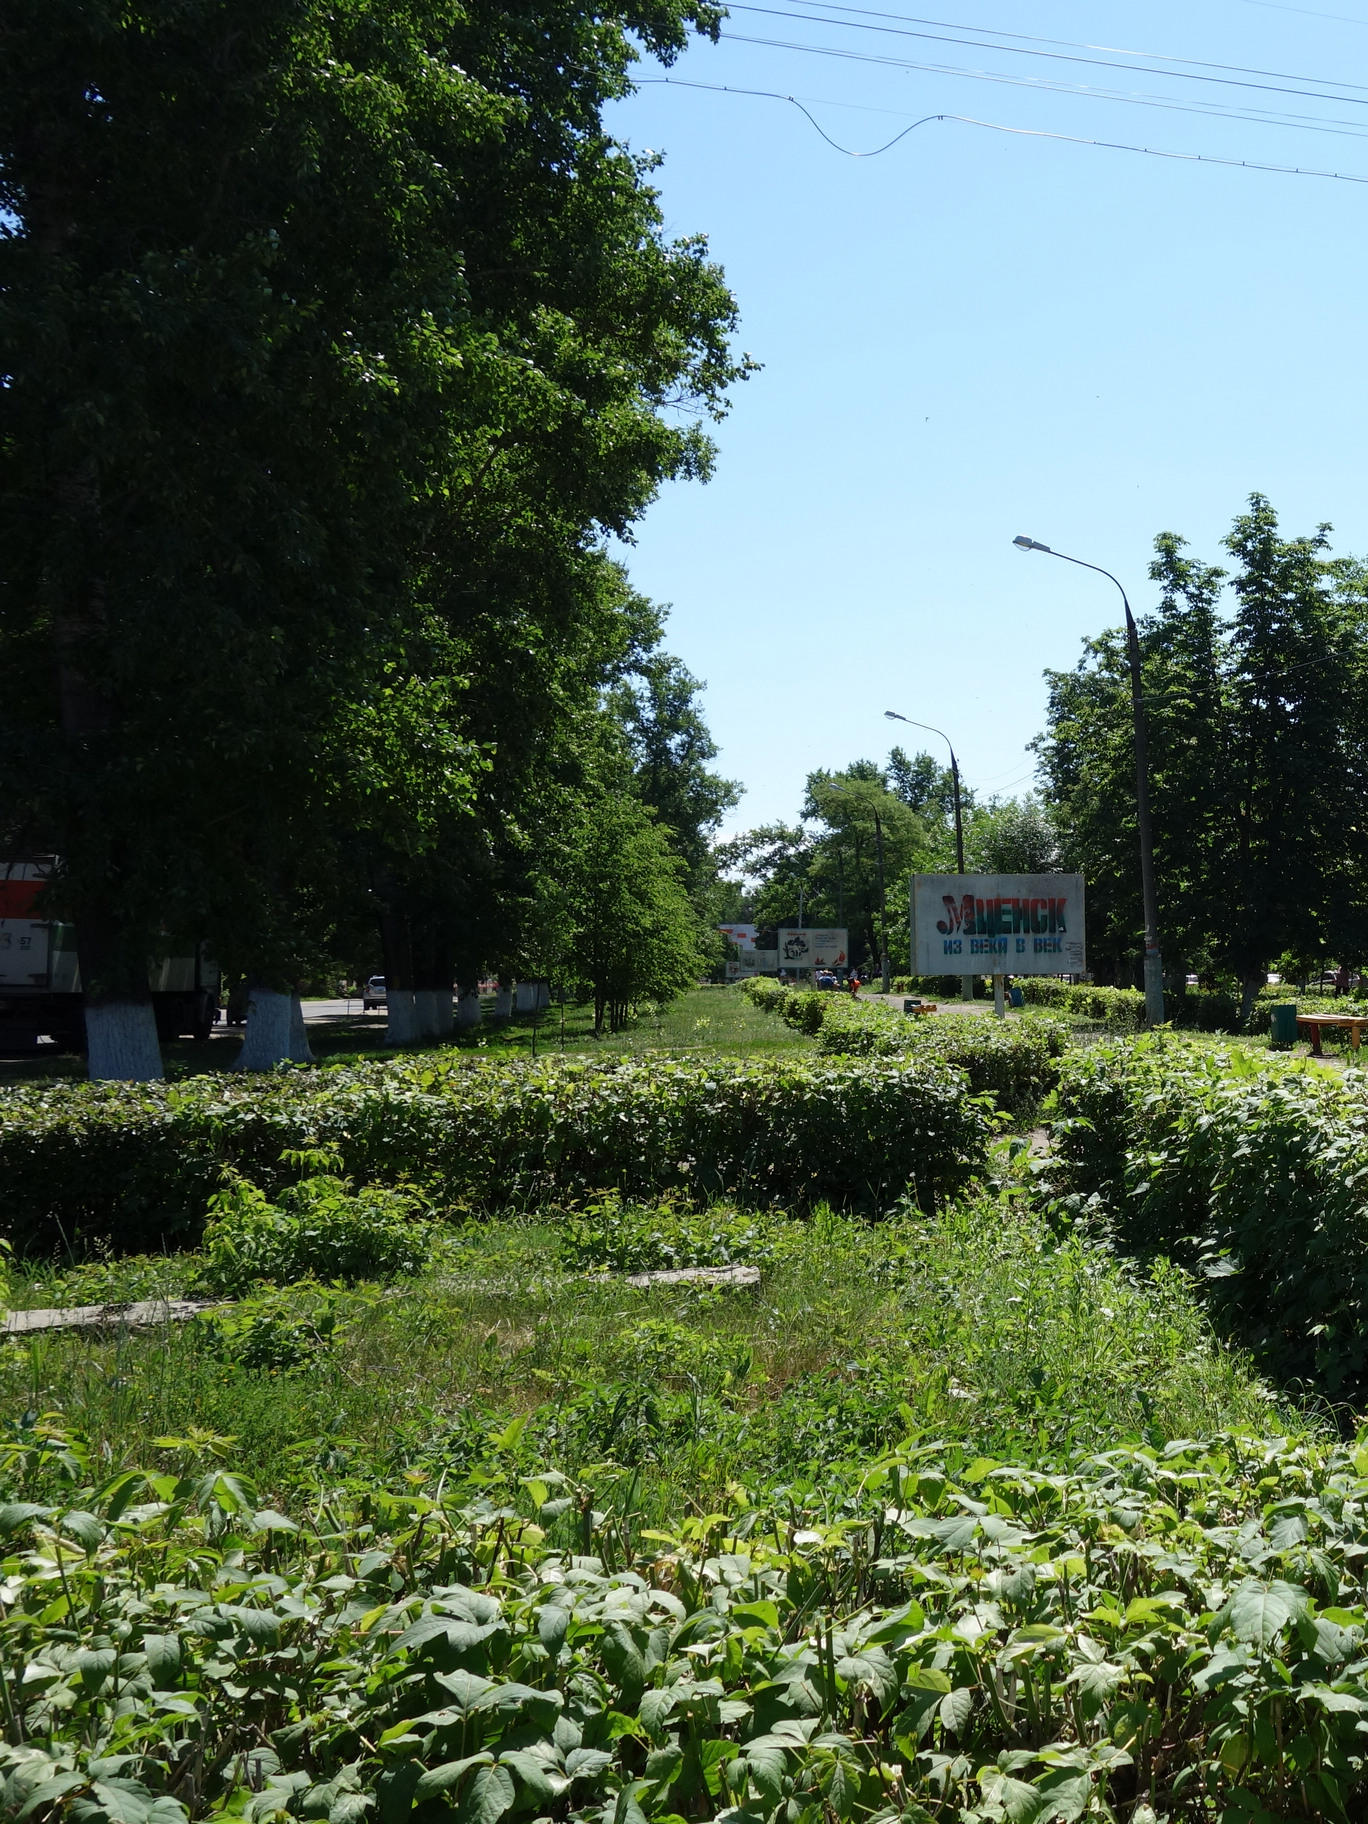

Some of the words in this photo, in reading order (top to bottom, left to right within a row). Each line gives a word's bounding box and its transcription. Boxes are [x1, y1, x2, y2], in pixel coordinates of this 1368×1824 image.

[936, 894, 1067, 938] МЦЕНСК
[943, 939, 963, 955] ИЗ
[970, 937, 1008, 954] ВЕКА
[1015, 938, 1026, 953] В
[1033, 937, 1063, 953] ВЕК
